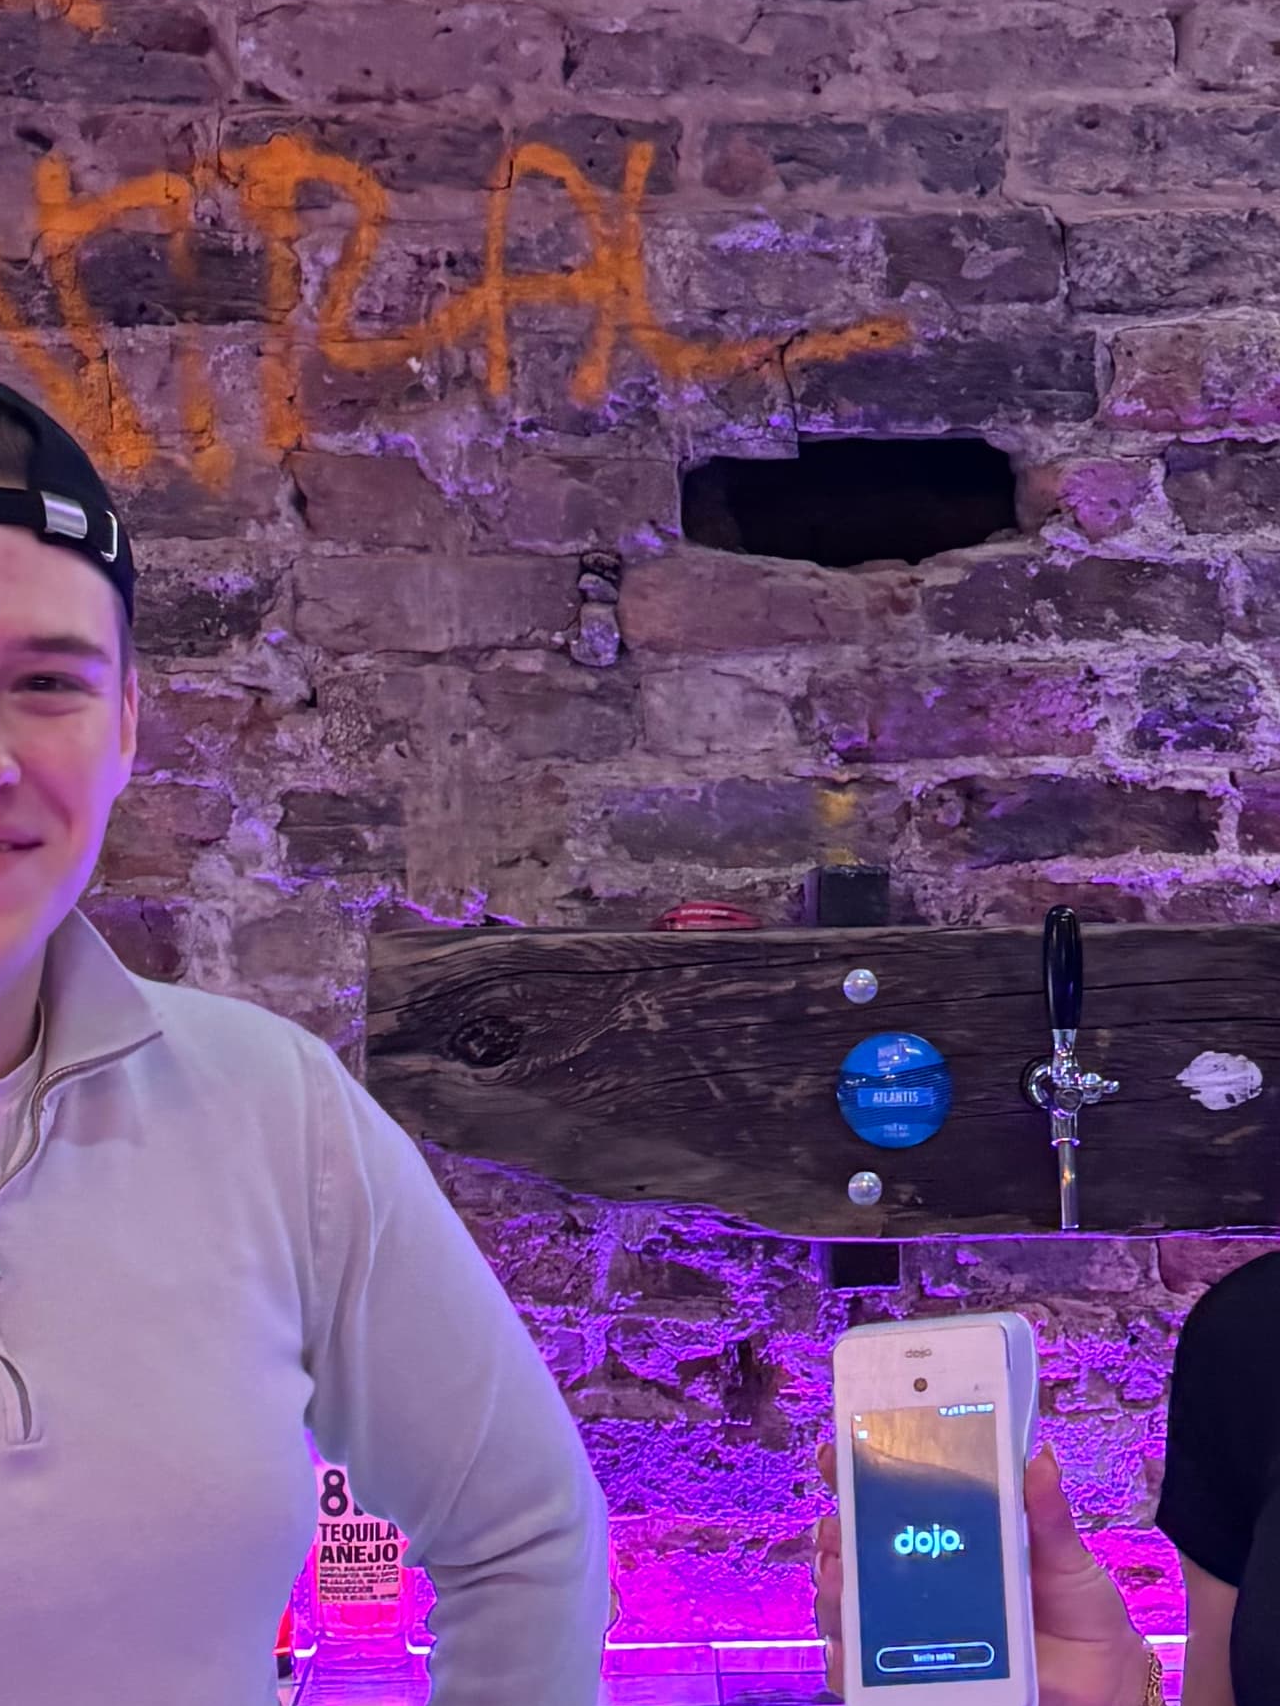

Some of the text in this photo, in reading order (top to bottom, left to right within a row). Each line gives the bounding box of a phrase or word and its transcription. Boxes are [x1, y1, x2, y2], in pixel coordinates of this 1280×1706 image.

[872, 1090, 919, 1104] ATLANTIS
[319, 1468, 364, 1517] 8
[318, 1522, 399, 1543] TEQUILA
[319, 1542, 399, 1564] AÑEJO
